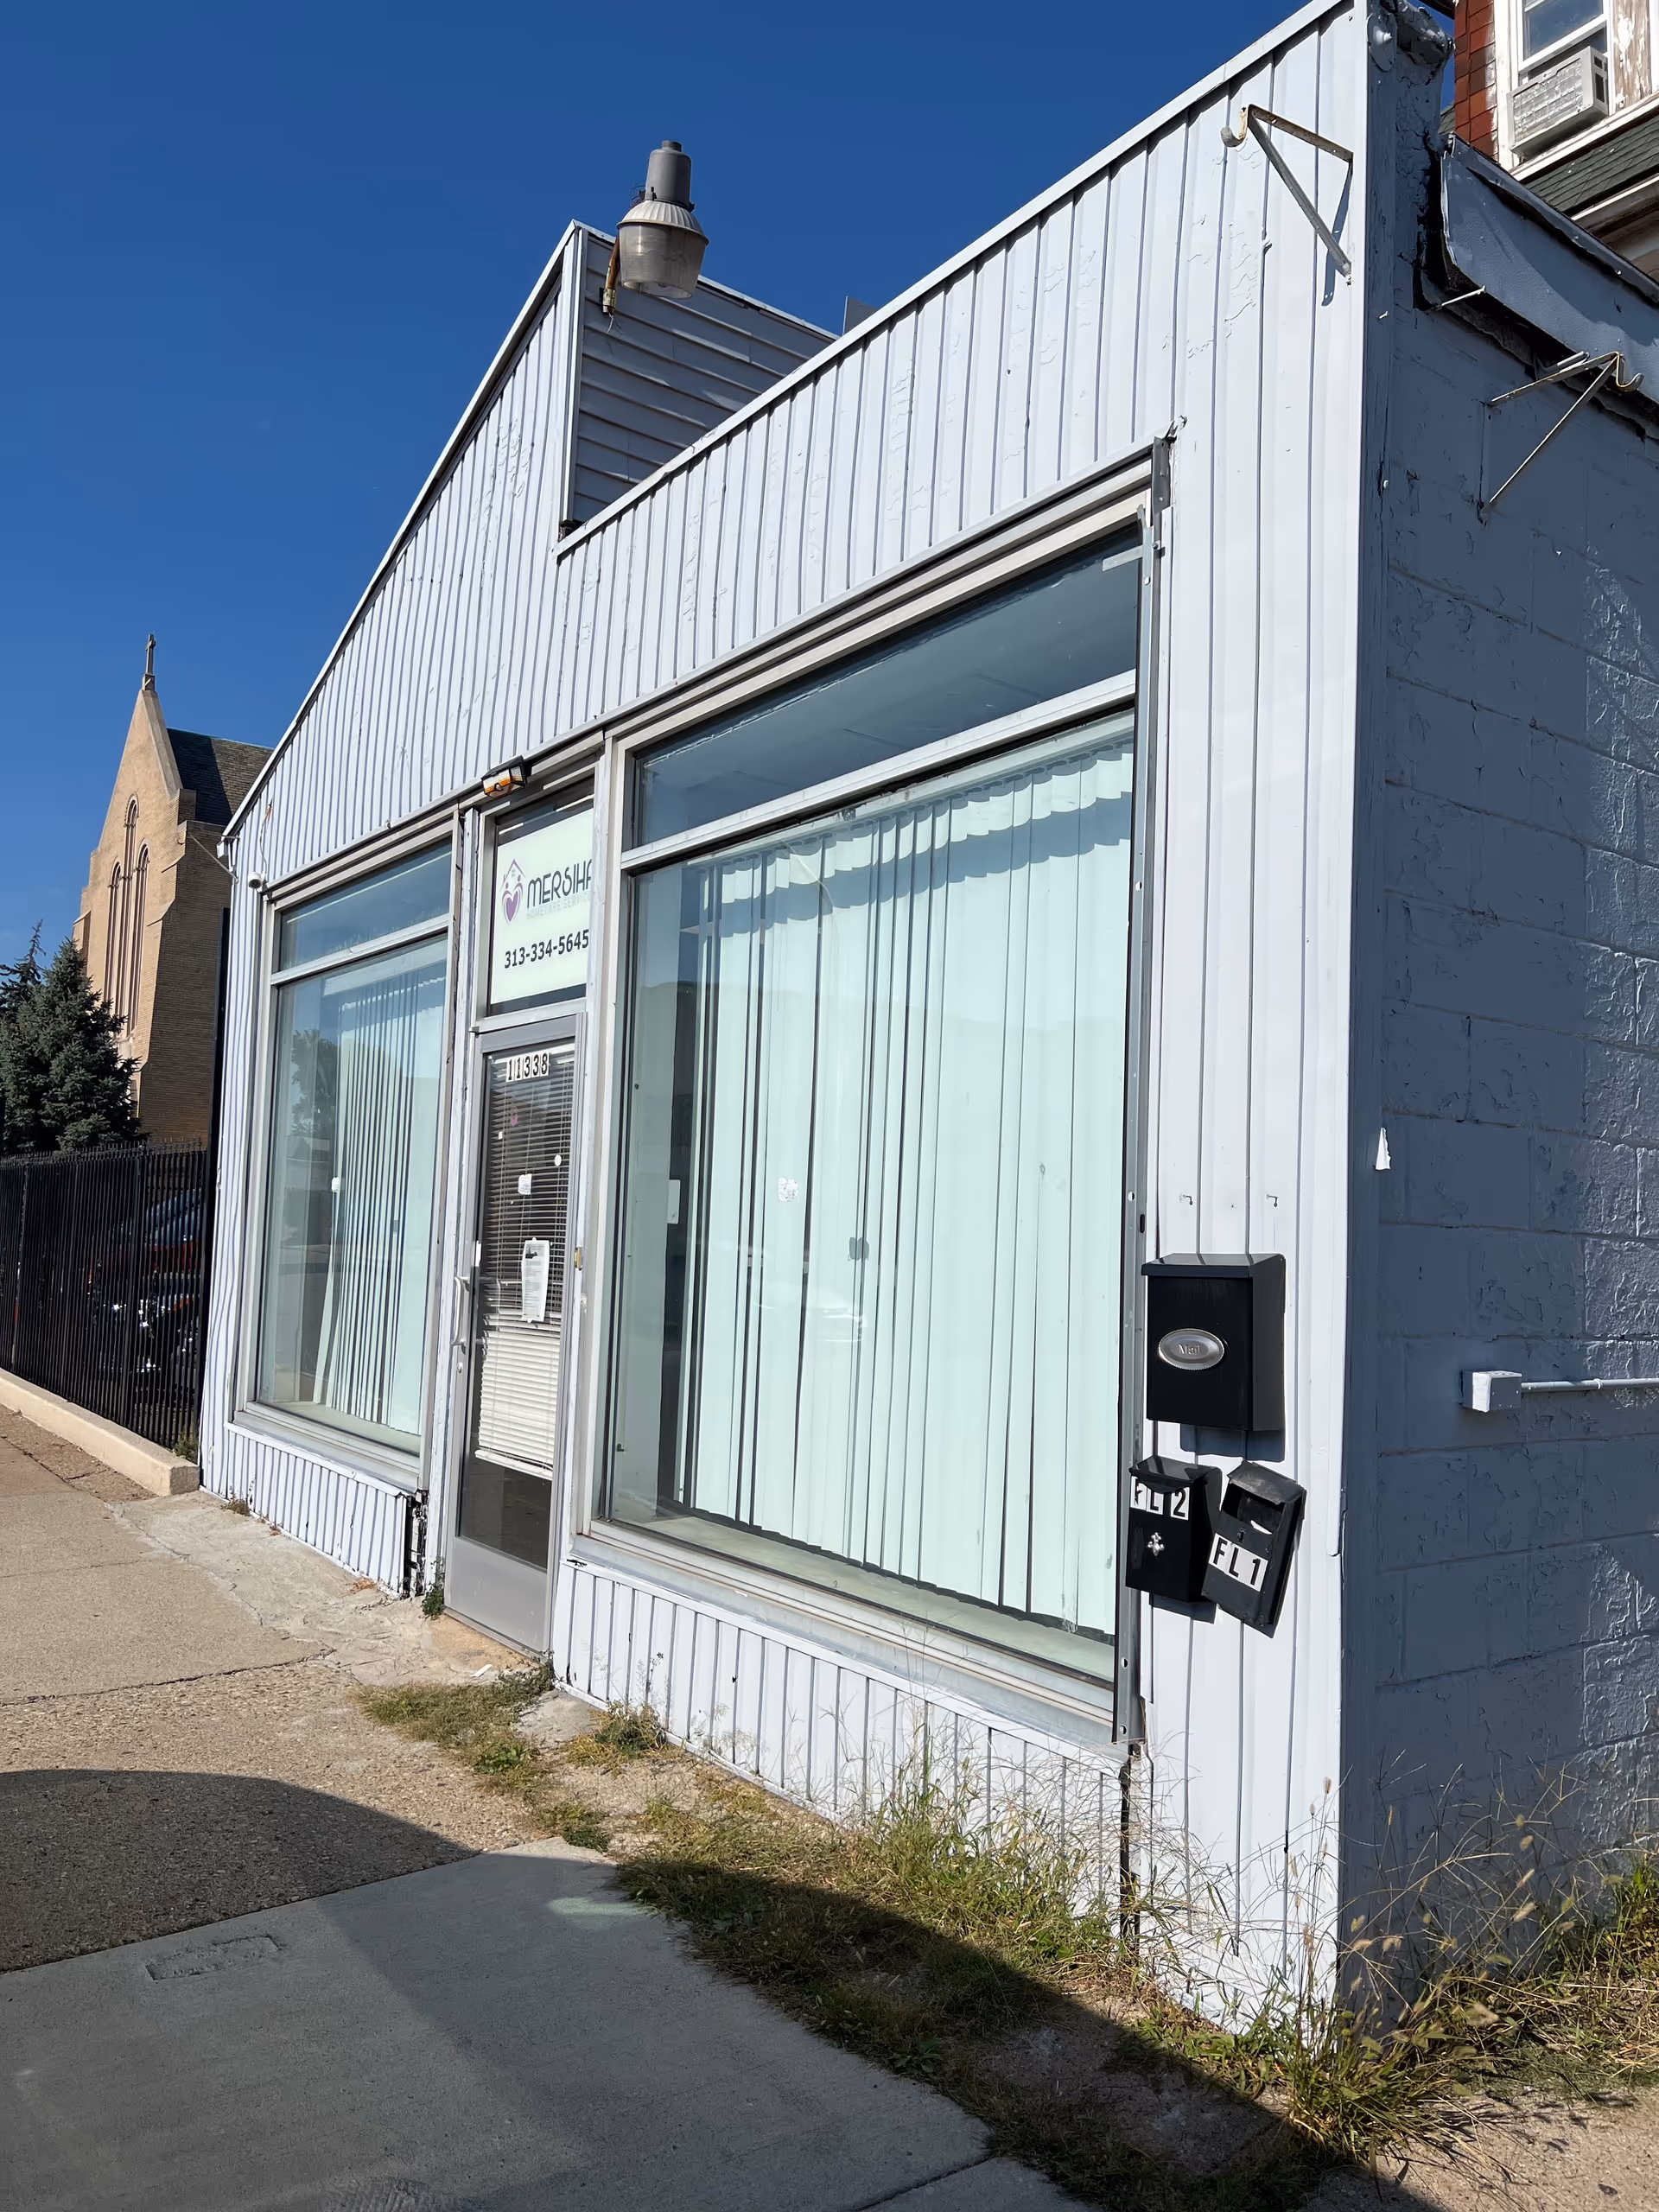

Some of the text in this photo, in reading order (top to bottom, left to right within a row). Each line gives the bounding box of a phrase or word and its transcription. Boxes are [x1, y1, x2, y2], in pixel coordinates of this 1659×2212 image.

[505, 929, 589, 969] 313-334-5645
[508, 1052, 548, 1080] 11338
[1178, 1344, 1200, 1355] Mail
[1173, 1488, 1185, 1517] 2
[1213, 1537, 1262, 1586] FL 1
